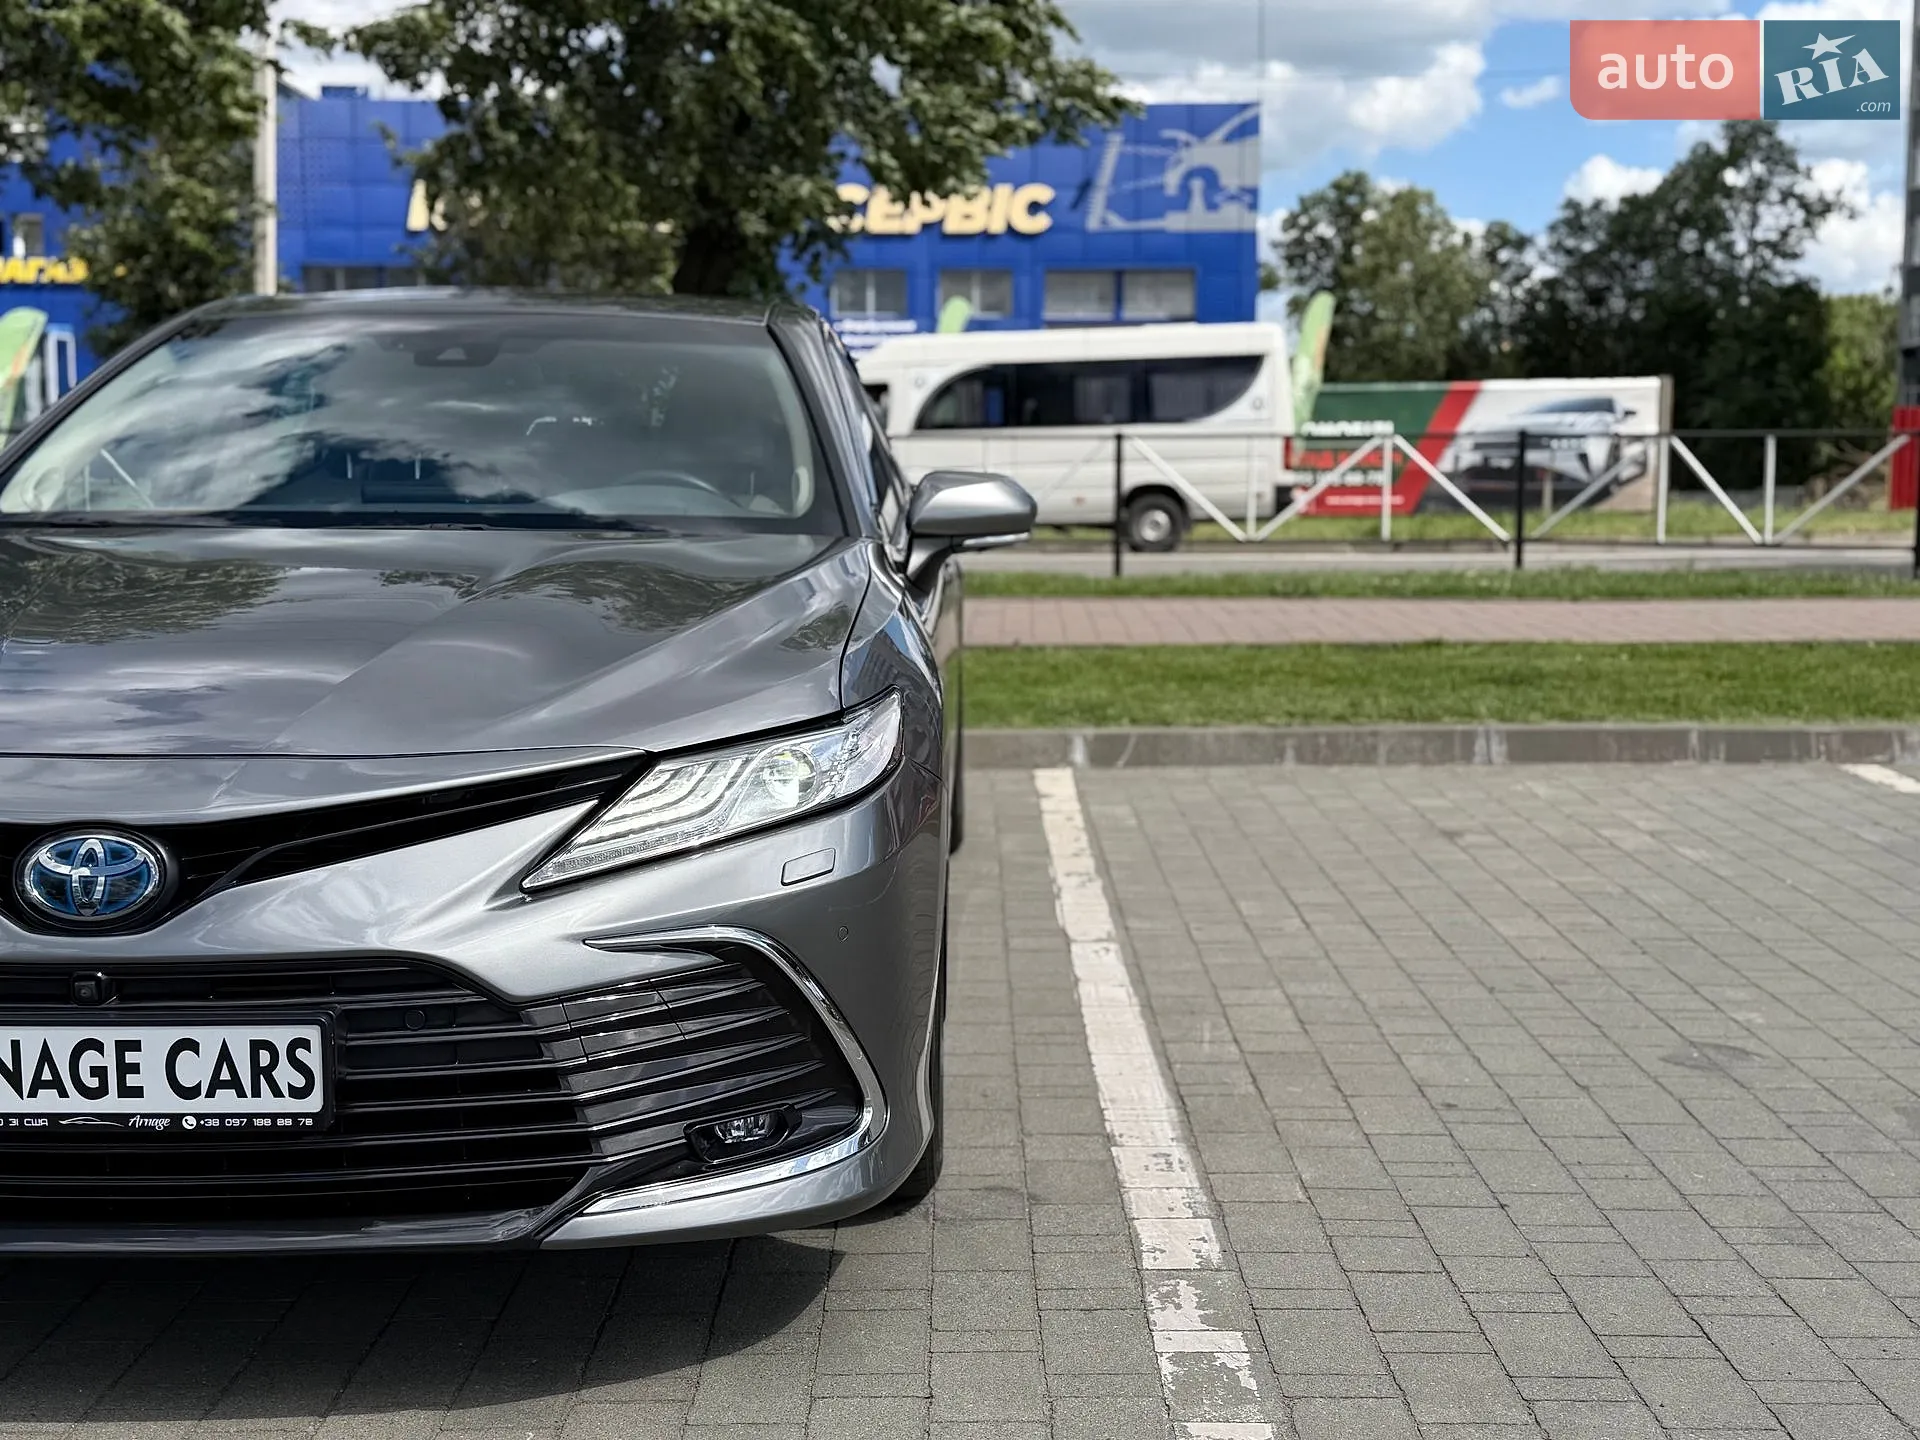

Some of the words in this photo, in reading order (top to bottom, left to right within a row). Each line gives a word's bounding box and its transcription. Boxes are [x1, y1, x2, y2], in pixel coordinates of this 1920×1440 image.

[165, 1037, 316, 1101] CARS
[128, 1114, 171, 1131] Arnage
[225, 1118, 247, 1127] 097
[253, 1118, 272, 1127] 188
[277, 1118, 293, 1127] 88
